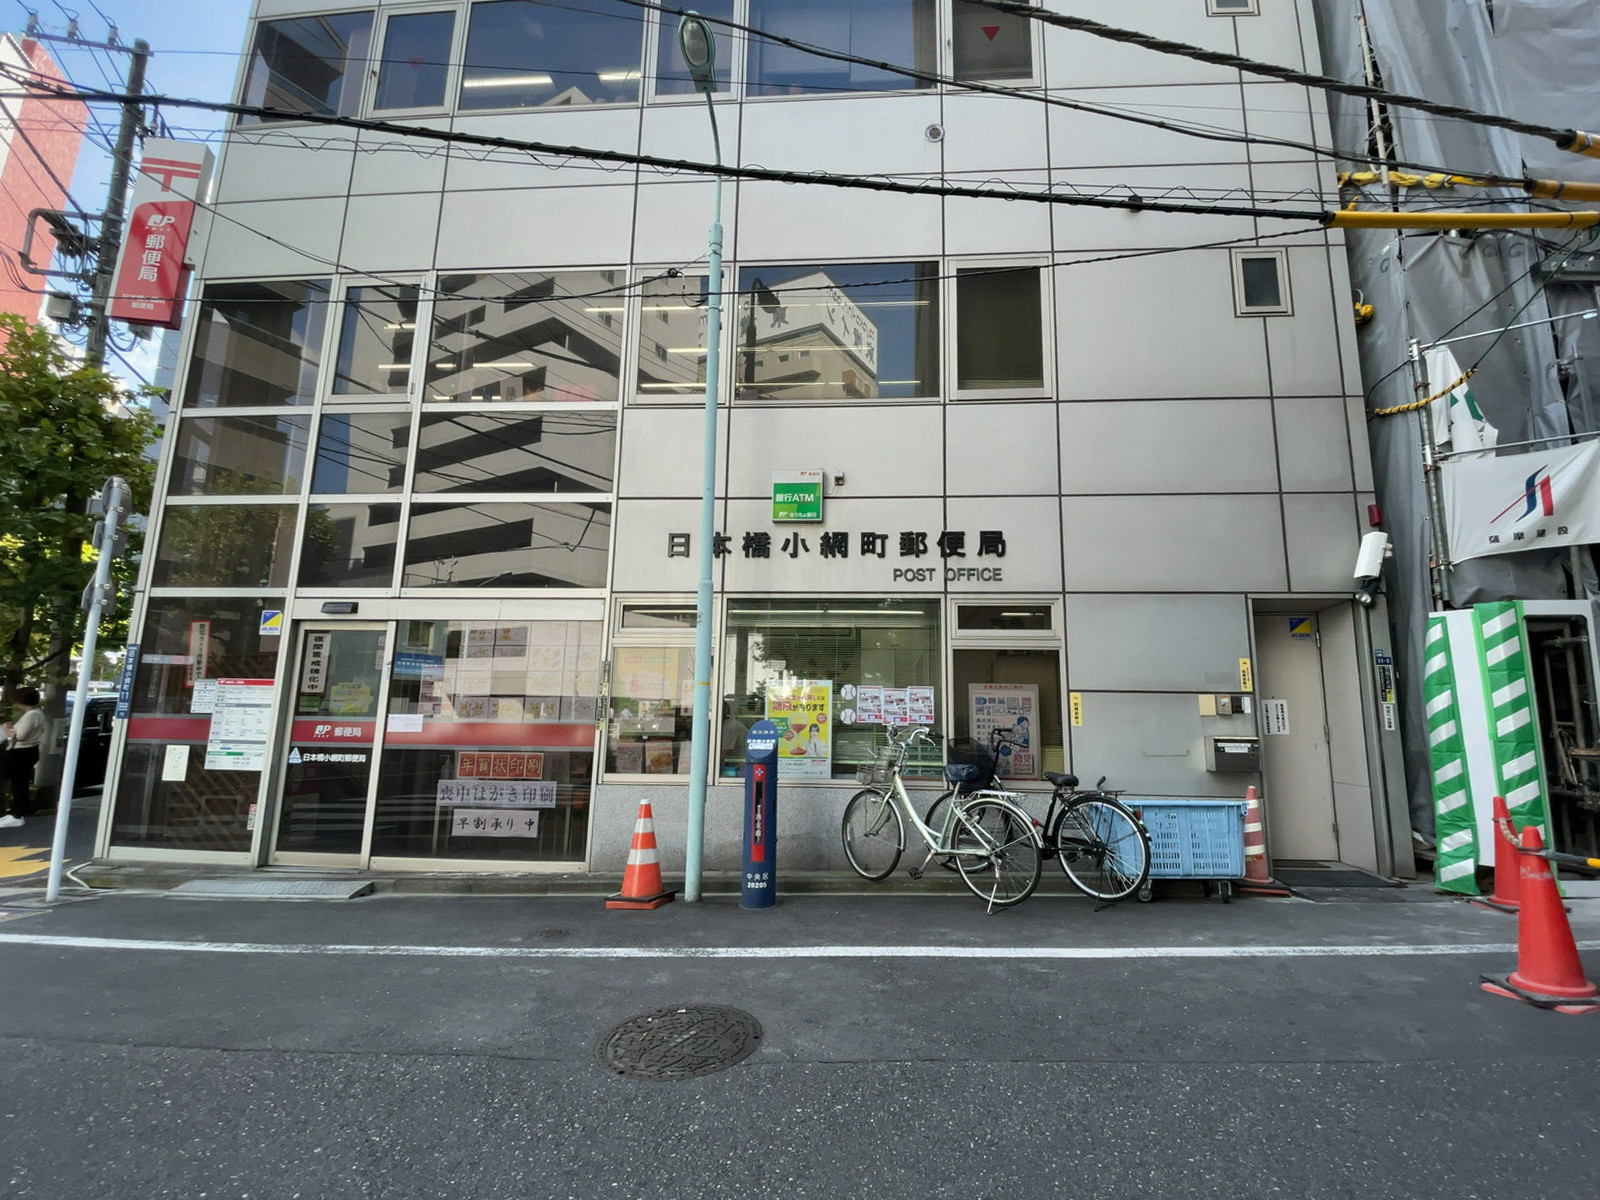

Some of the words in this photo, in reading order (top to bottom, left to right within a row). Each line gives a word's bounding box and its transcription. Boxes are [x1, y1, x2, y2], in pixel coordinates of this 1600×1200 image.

[137, 234, 165, 283] 郵便局
[775, 493, 814, 502] 銀行ATM
[667, 530, 1007, 559] 日本橋小網町郵便局
[892, 567, 936, 582] POST
[945, 567, 1003, 582] OFFICE
[334, 726, 362, 738] 郵便局
[303, 753, 367, 763] 日本橋小網町郵便局
[461, 757, 542, 774] 年賀状印刷
[439, 784, 555, 803] 喪中はがき印刷
[746, 873, 769, 881] 中央区
